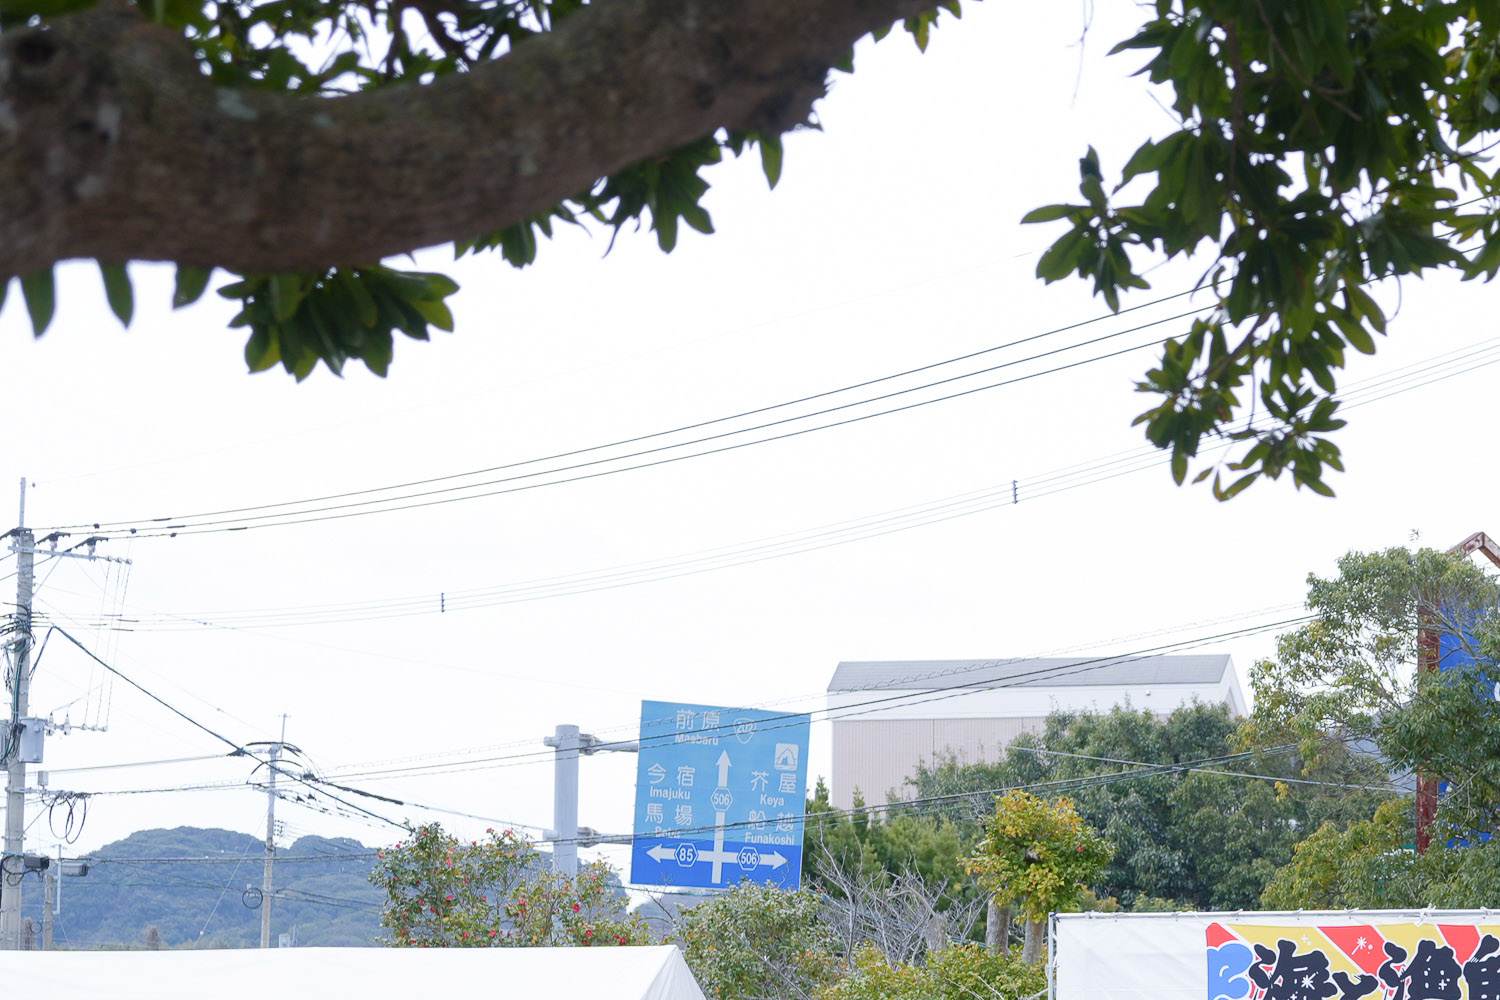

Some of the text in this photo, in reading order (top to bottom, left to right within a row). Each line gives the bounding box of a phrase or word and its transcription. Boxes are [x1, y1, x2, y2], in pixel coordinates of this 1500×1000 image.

[676, 710, 720, 731] 前原
[736, 723, 753, 734] 202
[647, 763, 696, 787] 今宿
[751, 771, 797, 794] 芥屋
[650, 787, 691, 800] Imajuku
[713, 794, 730, 806] 506
[760, 795, 785, 808] Keya
[645, 803, 693, 826] 馬場
[748, 810, 794, 832] 船越
[745, 832, 795, 846] Funakoshi
[679, 849, 693, 861] 85
[740, 853, 757, 865] 506
